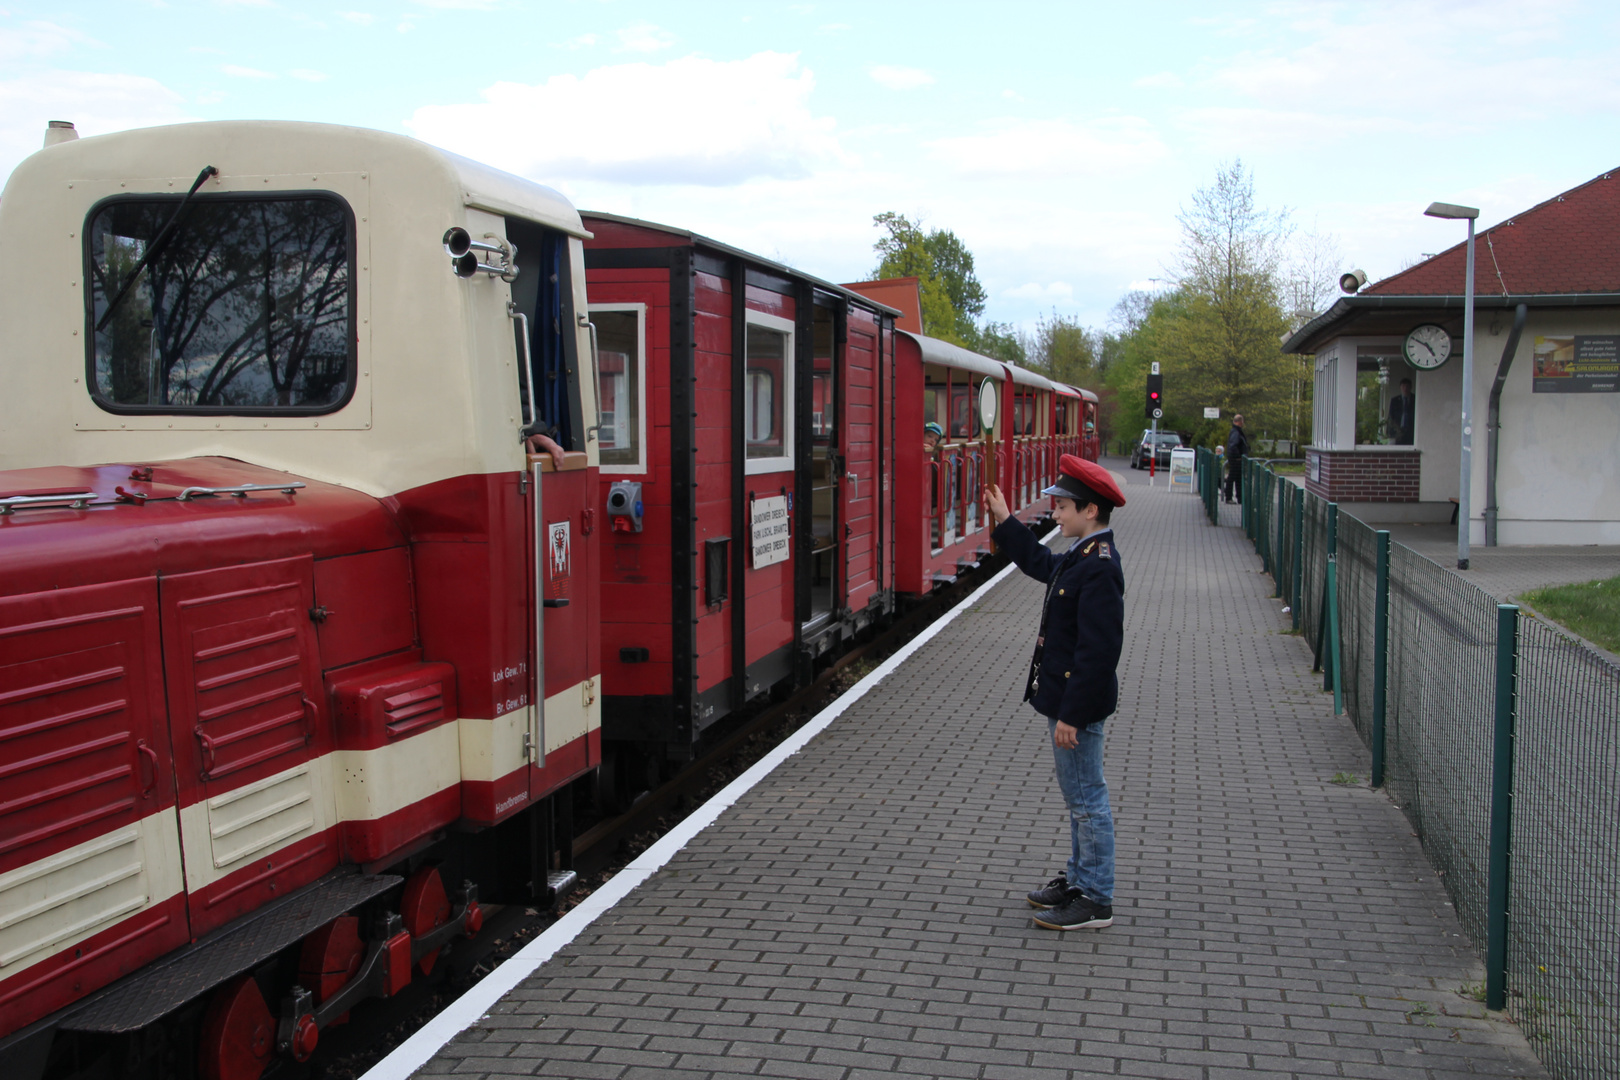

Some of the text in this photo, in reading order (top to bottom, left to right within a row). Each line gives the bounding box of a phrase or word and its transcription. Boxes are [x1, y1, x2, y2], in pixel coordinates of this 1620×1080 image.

[493, 669, 504, 682] Lok
[505, 667, 518, 678] Gew.
[519, 663, 522, 673] 7
[496, 703, 505, 714] Br.
[506, 699, 519, 710] Gew.
[520, 694, 524, 705] 6
[495, 791, 528, 814] Handbremse
